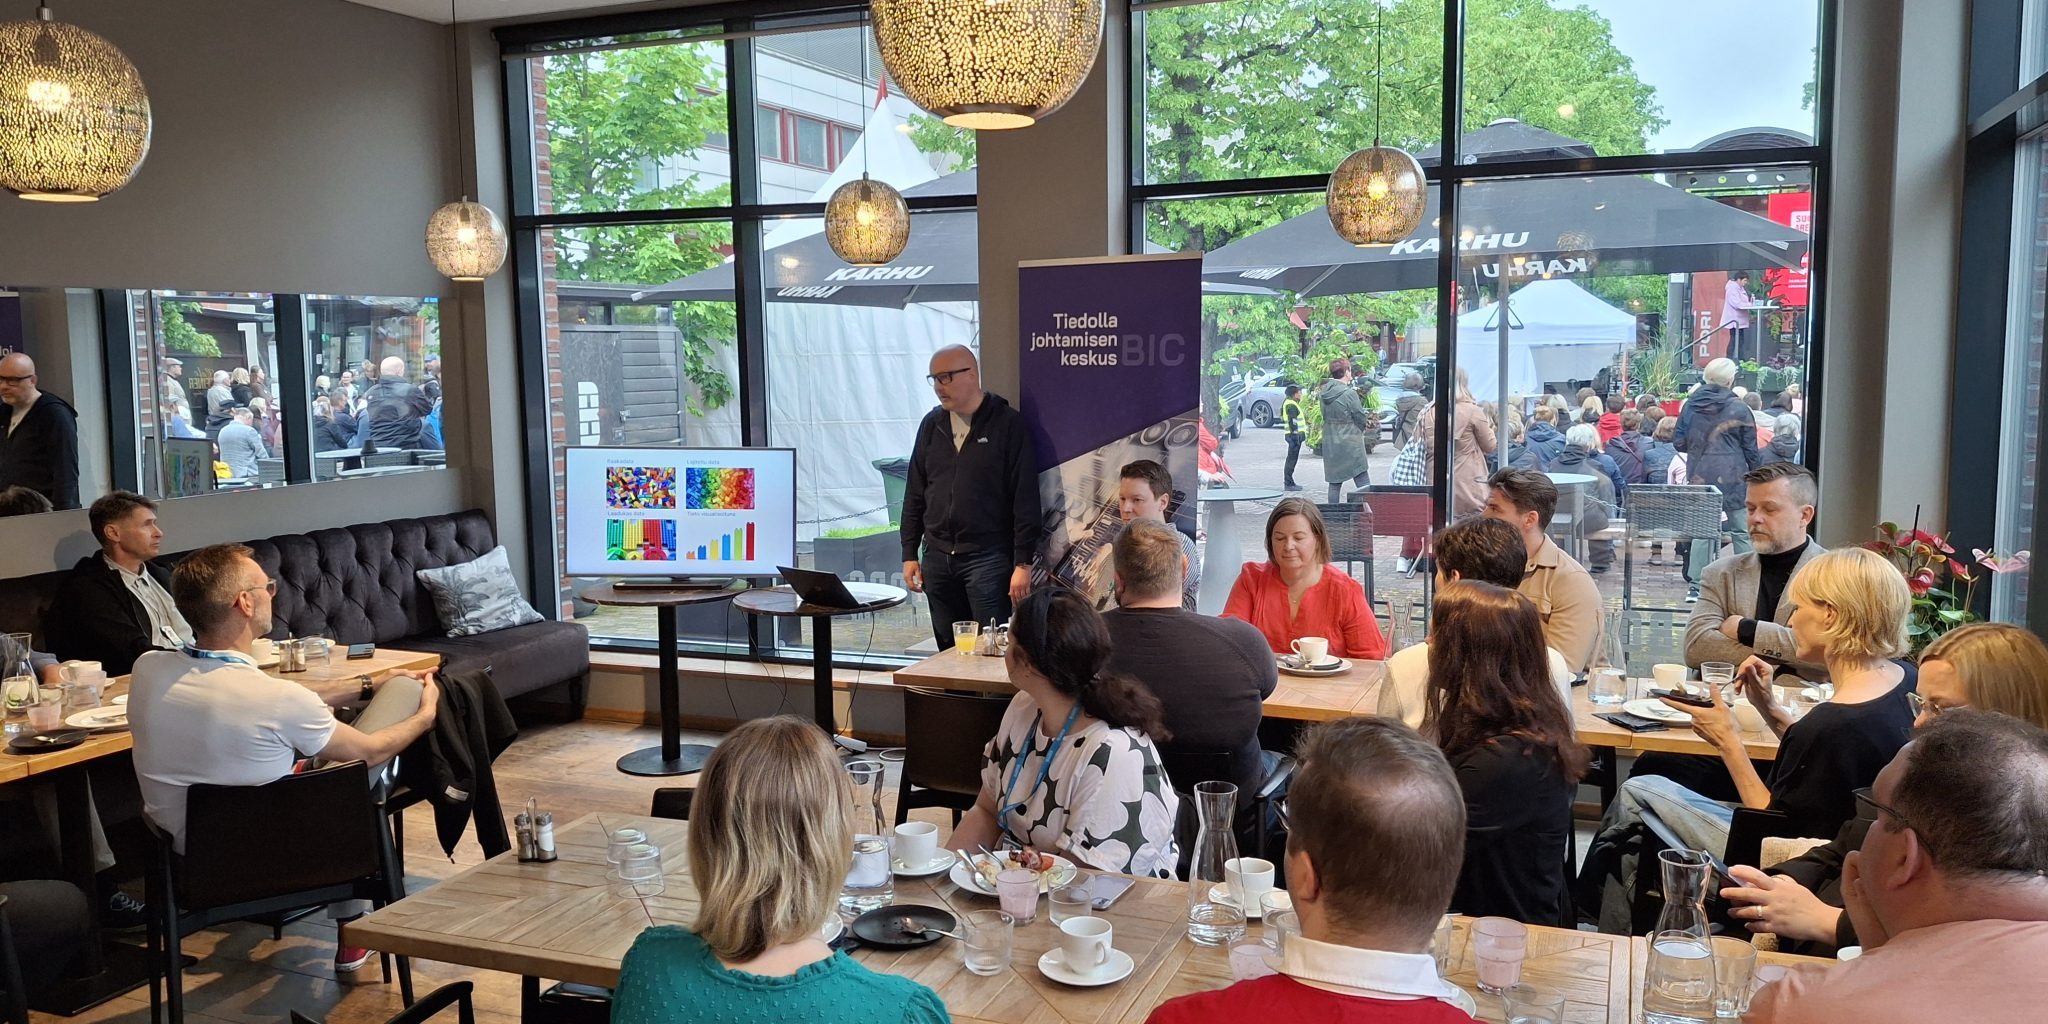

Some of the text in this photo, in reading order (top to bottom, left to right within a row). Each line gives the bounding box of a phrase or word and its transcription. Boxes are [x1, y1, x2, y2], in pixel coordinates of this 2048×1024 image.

[1389, 231, 1530, 255] KARHU
[824, 265, 935, 281] KARHU
[1053, 312, 1118, 329] Tiedolla
[1030, 331, 1118, 351] johtamisen
[1699, 311, 1712, 357] PORI
[1060, 350, 1117, 366] keskus
[1121, 333, 1185, 366] BIC
